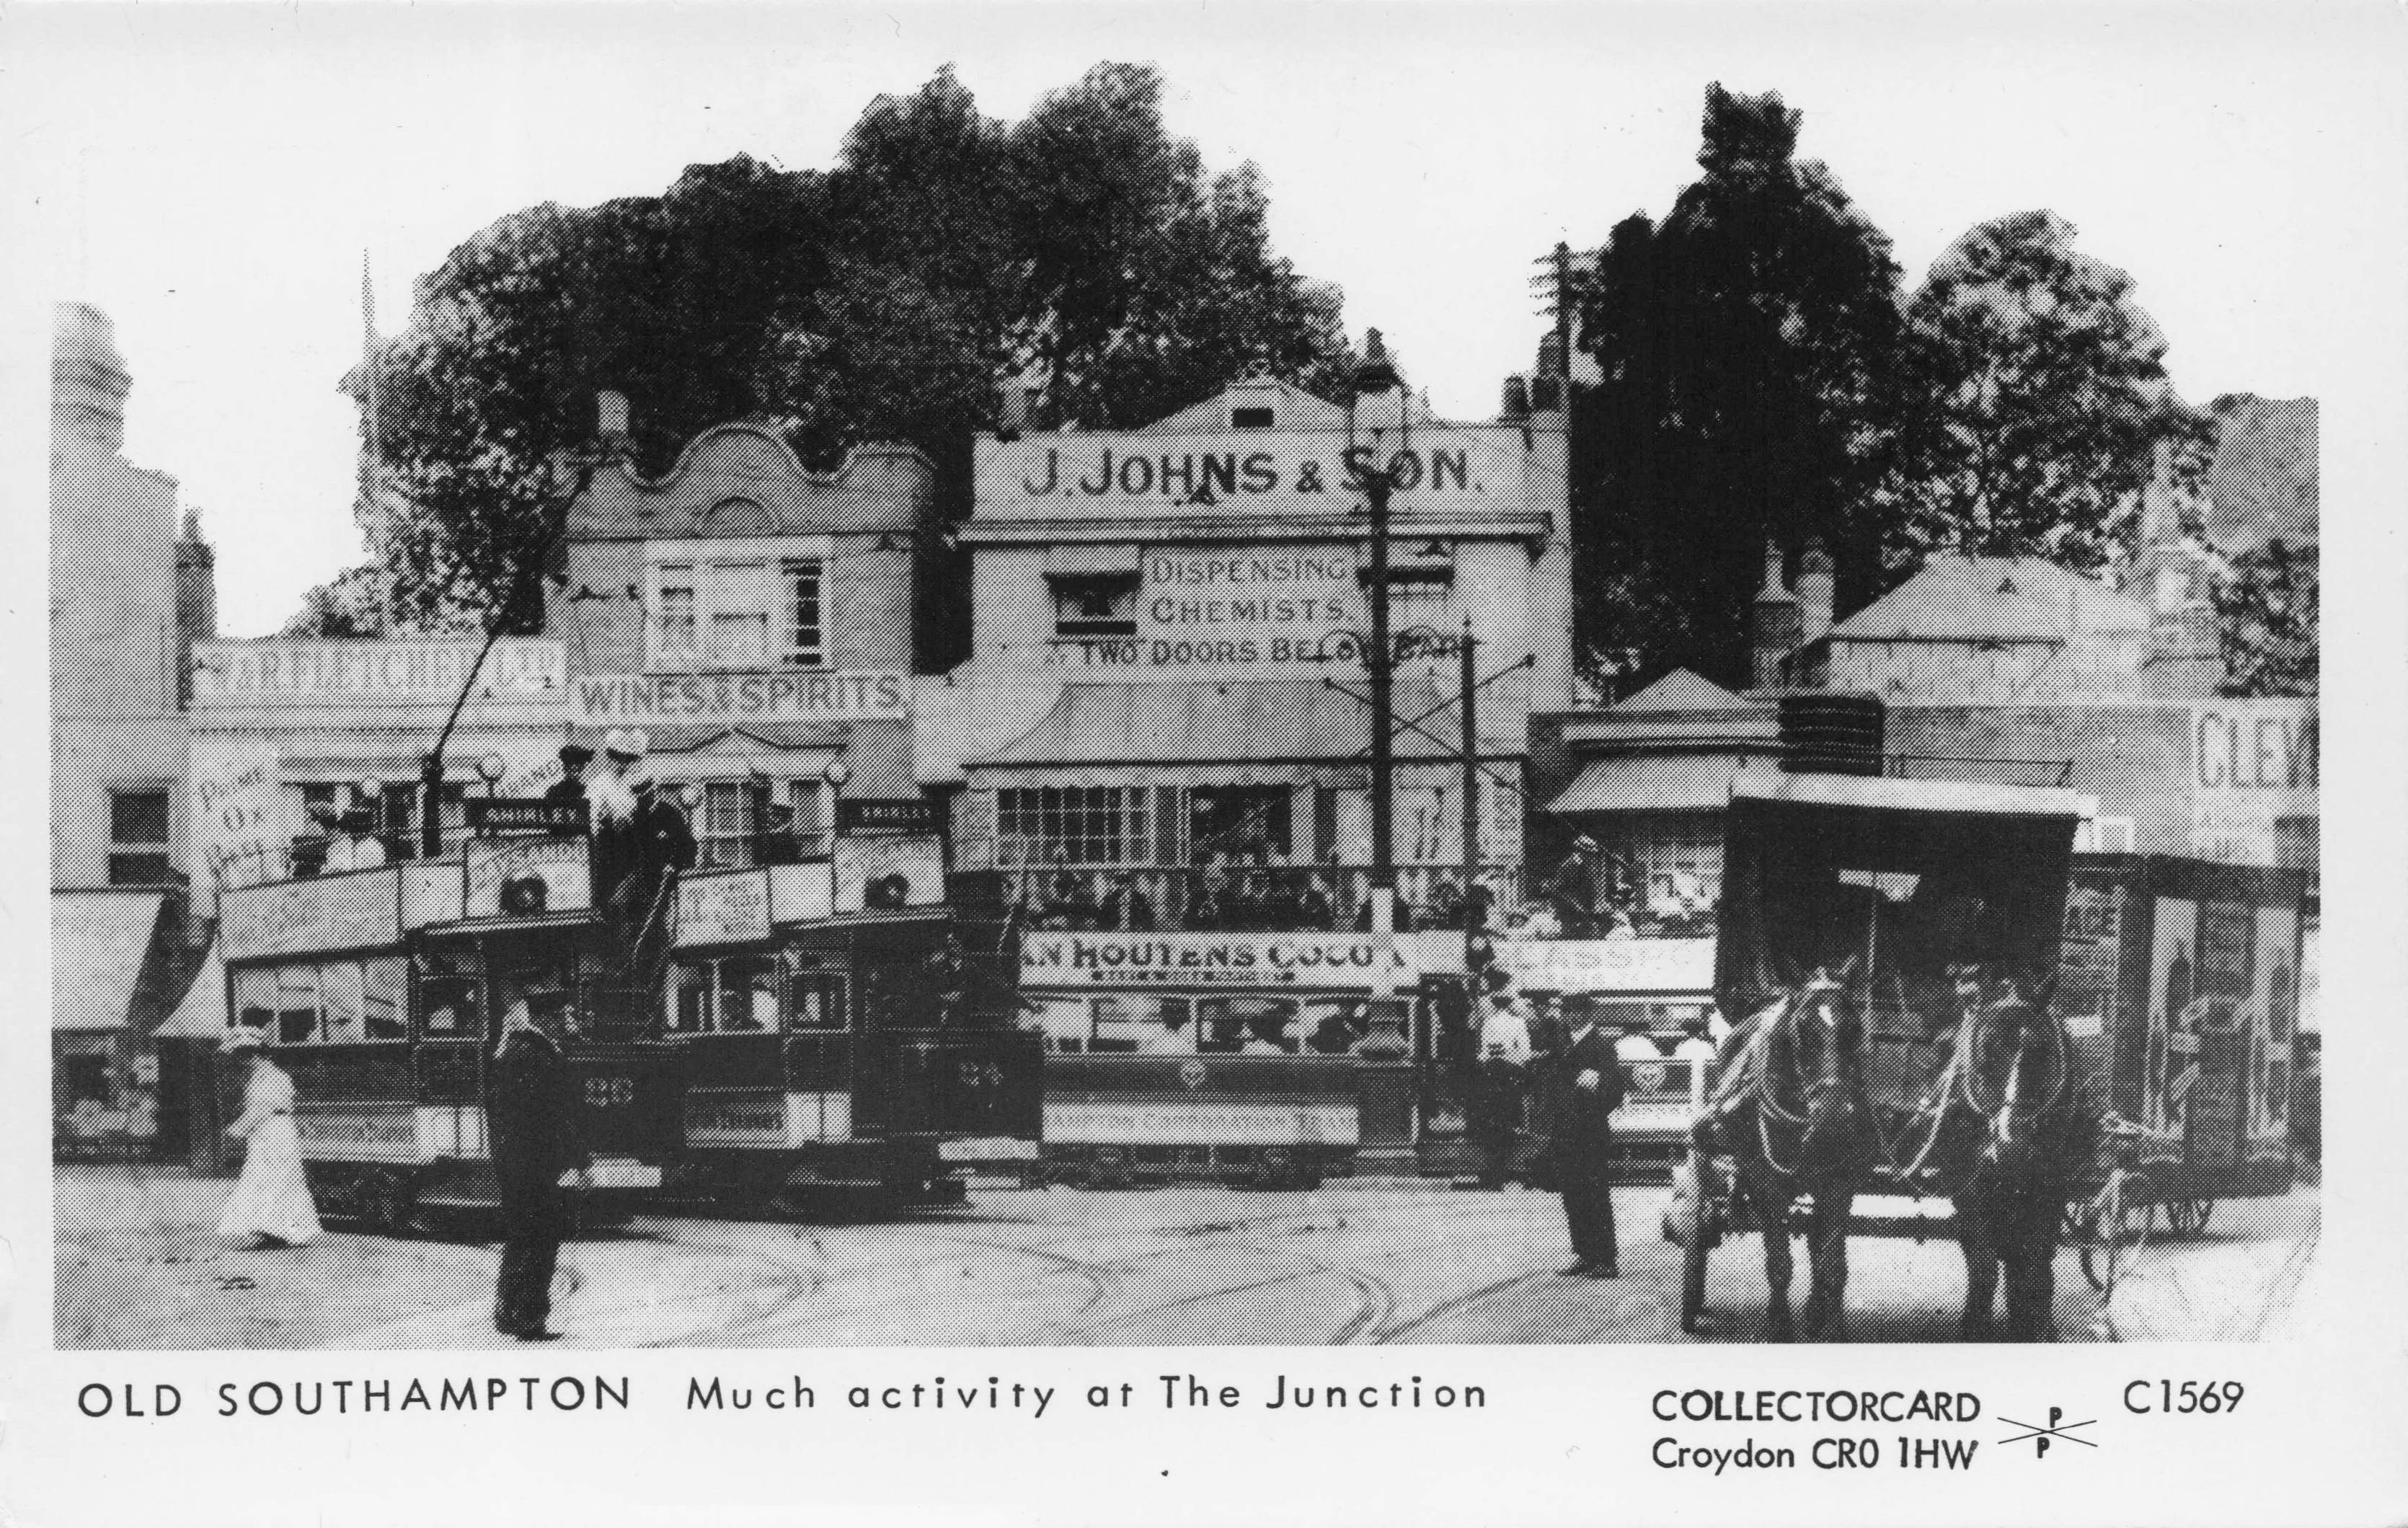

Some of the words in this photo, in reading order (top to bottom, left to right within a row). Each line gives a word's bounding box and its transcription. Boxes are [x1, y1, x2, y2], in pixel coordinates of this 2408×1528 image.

[1296, 460, 1322, 493] &
[1151, 557, 1347, 585] DISPENSING
[1079, 641, 1138, 665] TWO
[1151, 640, 1257, 664] DOORS
[581, 679, 704, 715] WINES
[709, 682, 727, 712] &
[738, 676, 903, 713] SPIRITS
[484, 806, 579, 824] SHIRLEY
